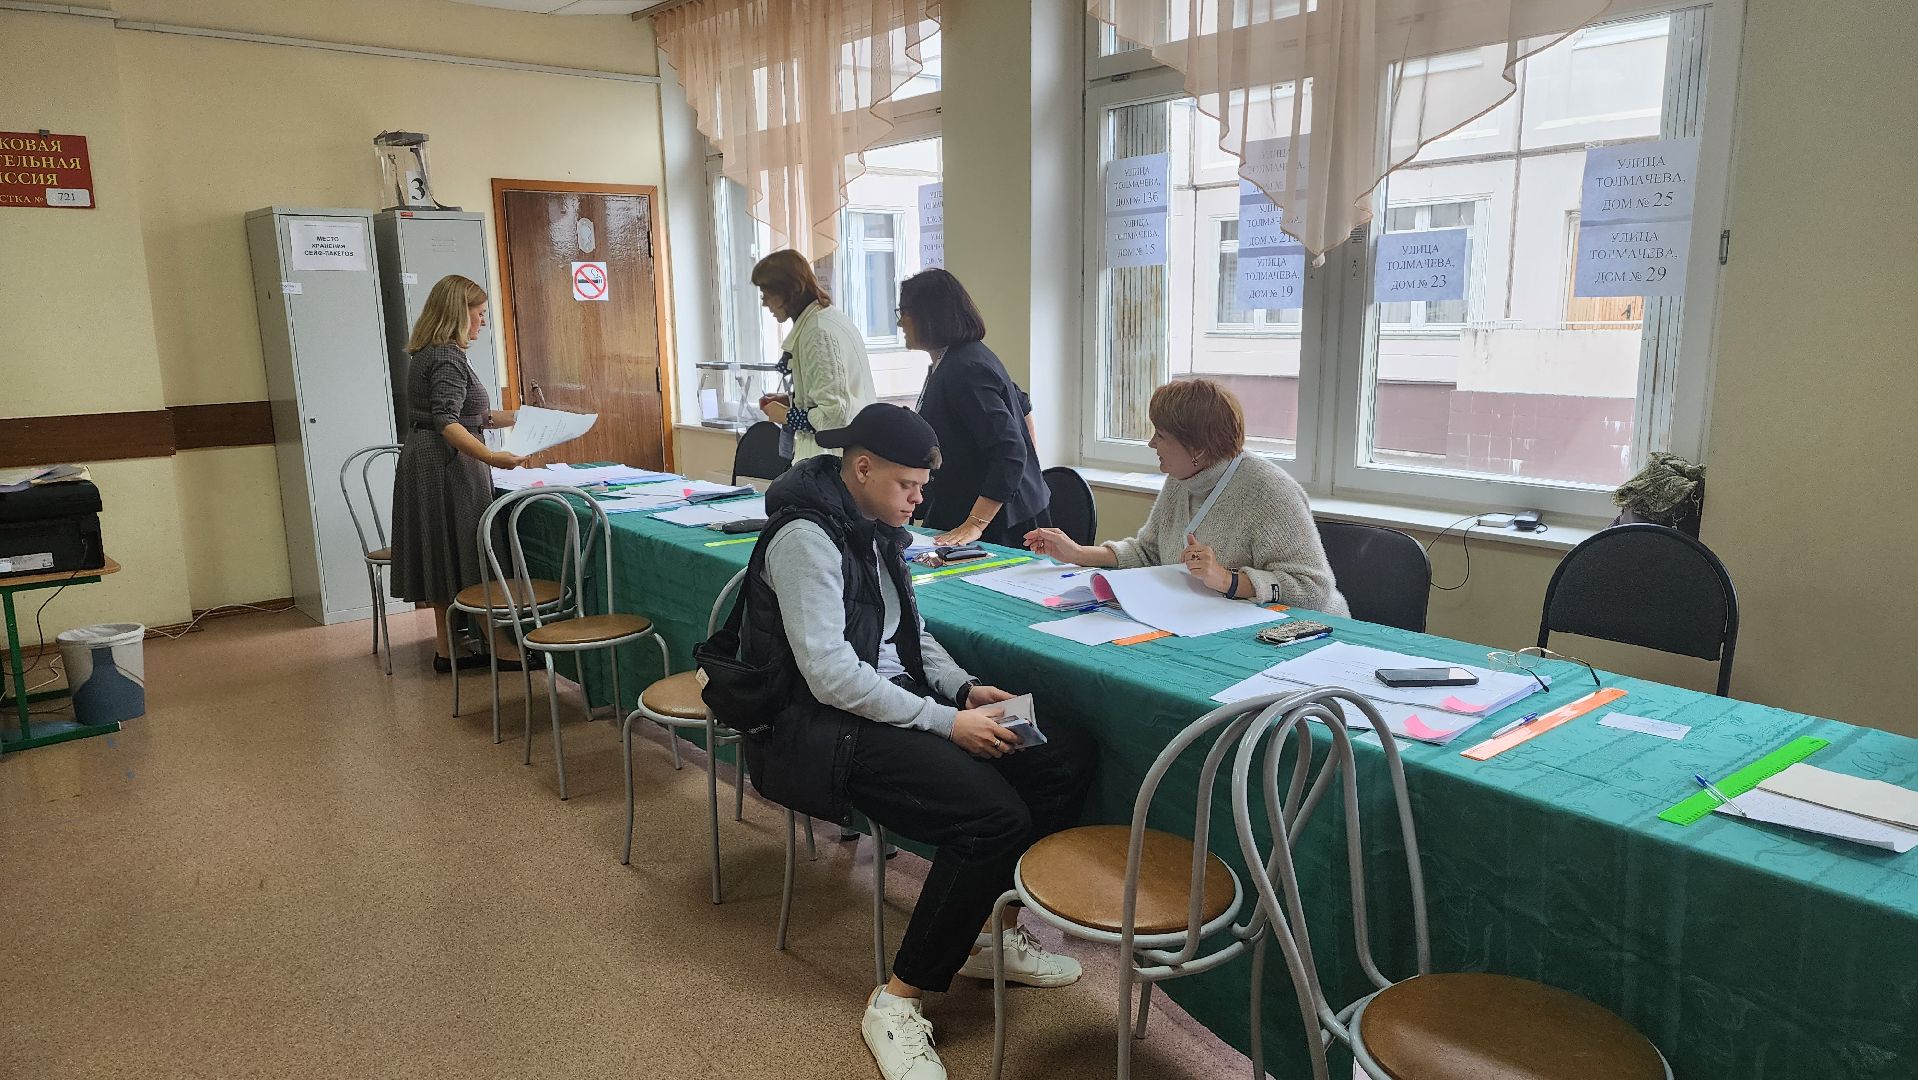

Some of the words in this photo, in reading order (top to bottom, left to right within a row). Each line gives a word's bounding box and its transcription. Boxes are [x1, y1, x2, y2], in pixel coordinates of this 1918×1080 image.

[0, 155, 81, 170] ЕЛЬНАЯ
[1617, 156, 1666, 169] УЛИЦА
[1124, 166, 1150, 176] УЛИЦА
[1596, 172, 1686, 187] ТОЛМАЧЕВА,
[411, 177, 425, 200] 3
[57, 192, 75, 201] 721
[1115, 198, 1132, 207] ДОМ
[1602, 199, 1632, 211] ДОМ
[1636, 198, 1650, 209] №
[1653, 191, 1674, 207] 25
[1124, 219, 1149, 228] УЛИЦА
[1249, 235, 1267, 247] ДОМ
[1610, 231, 1659, 243] УЛИЦА
[1117, 247, 1134, 258] ДОМ
[1402, 244, 1439, 255] УЛИЦА
[1590, 247, 1678, 260] ТОЛМАЧЕВА,
[1257, 257, 1287, 268] УЛИЦА
[1387, 258, 1455, 271] ТОЛМАЧЕВА,
[1245, 270, 1300, 280] ТОЛМАЧЕВА,
[1595, 271, 1626, 284] ДОМ
[1629, 271, 1642, 282] №
[1646, 266, 1667, 282] 29
[1391, 280, 1416, 291] ДОМ
[1417, 279, 1428, 288] №
[1430, 274, 1447, 288] 23
[1249, 288, 1268, 299] ДОМ
[1281, 285, 1294, 297] 19
